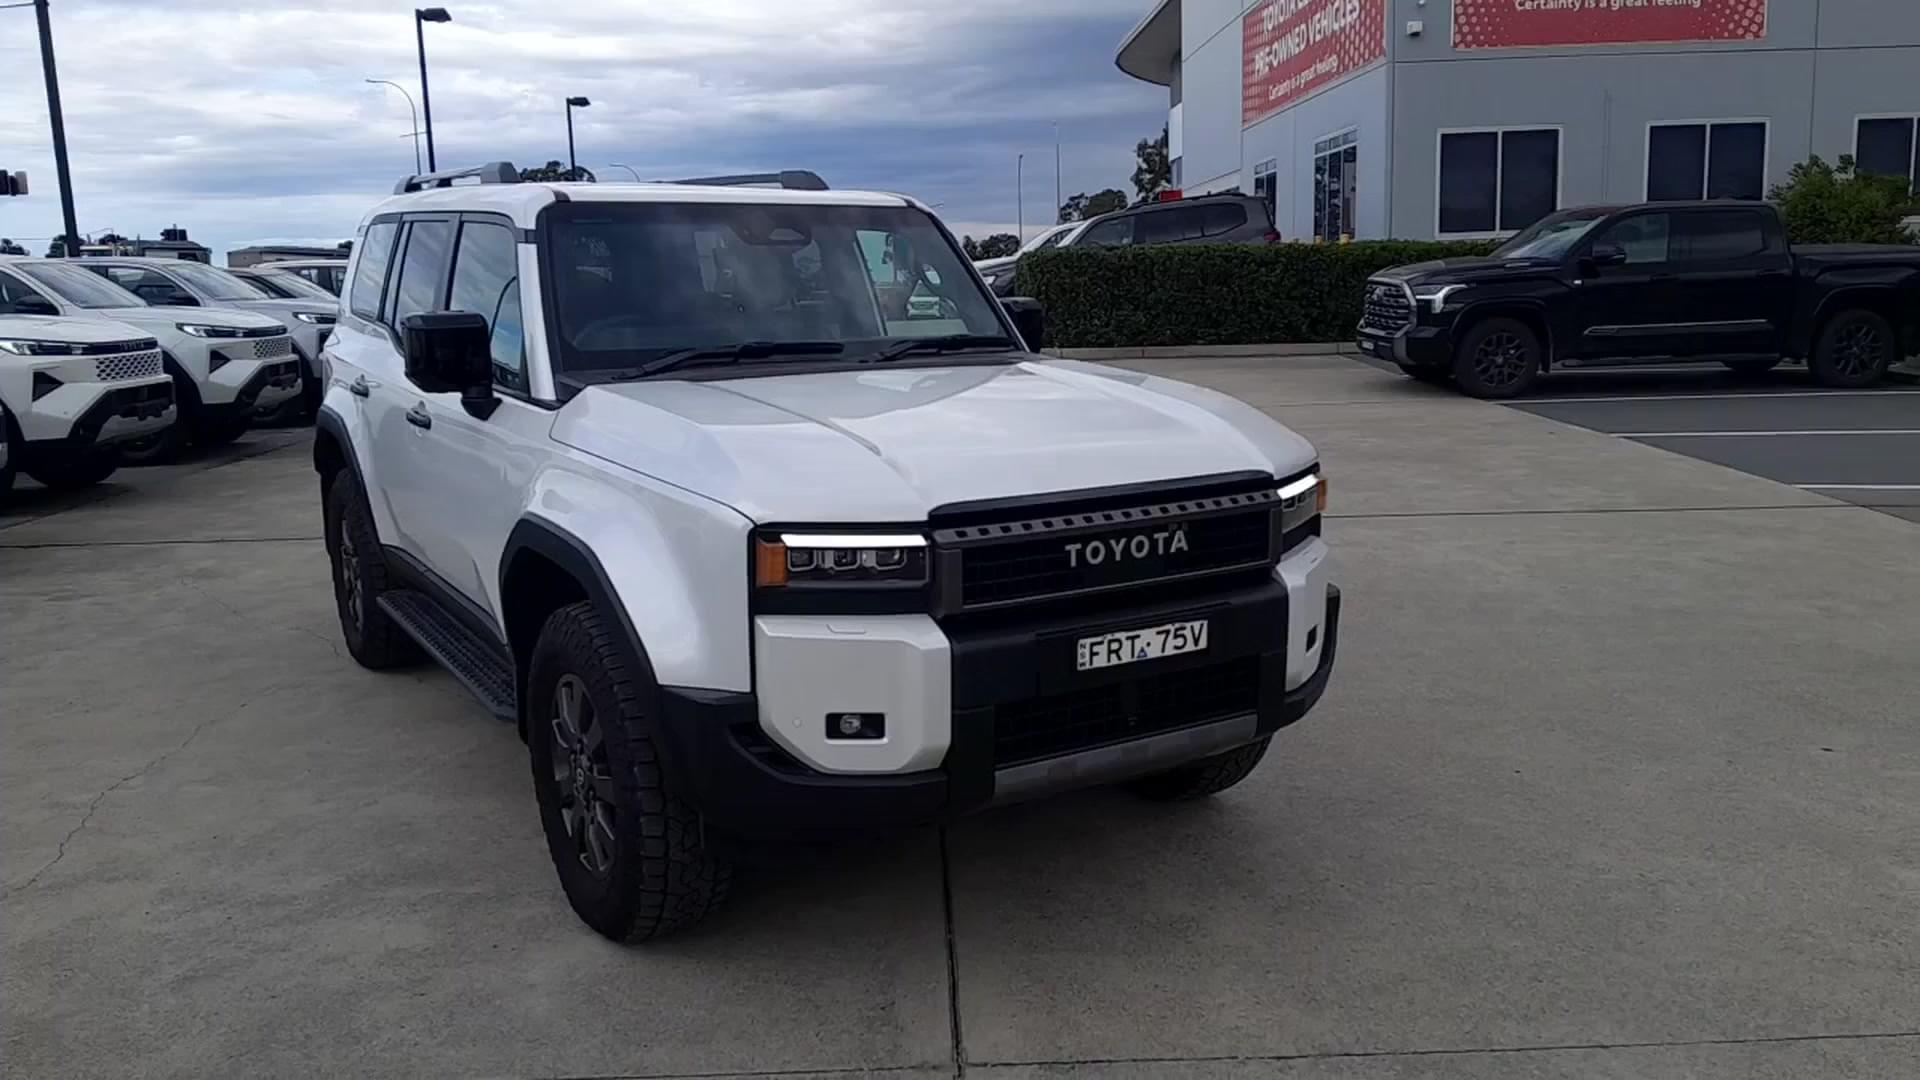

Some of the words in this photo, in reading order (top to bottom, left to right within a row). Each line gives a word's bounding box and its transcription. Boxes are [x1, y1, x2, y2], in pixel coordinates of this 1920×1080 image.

[1515, 0, 1580, 11] Certainty
[1610, 0, 1648, 10] great
[1254, 23, 1307, 79] PRE-OWNED
[1307, 0, 1360, 46] VEHICLES
[1065, 530, 1188, 568] TOYOTA
